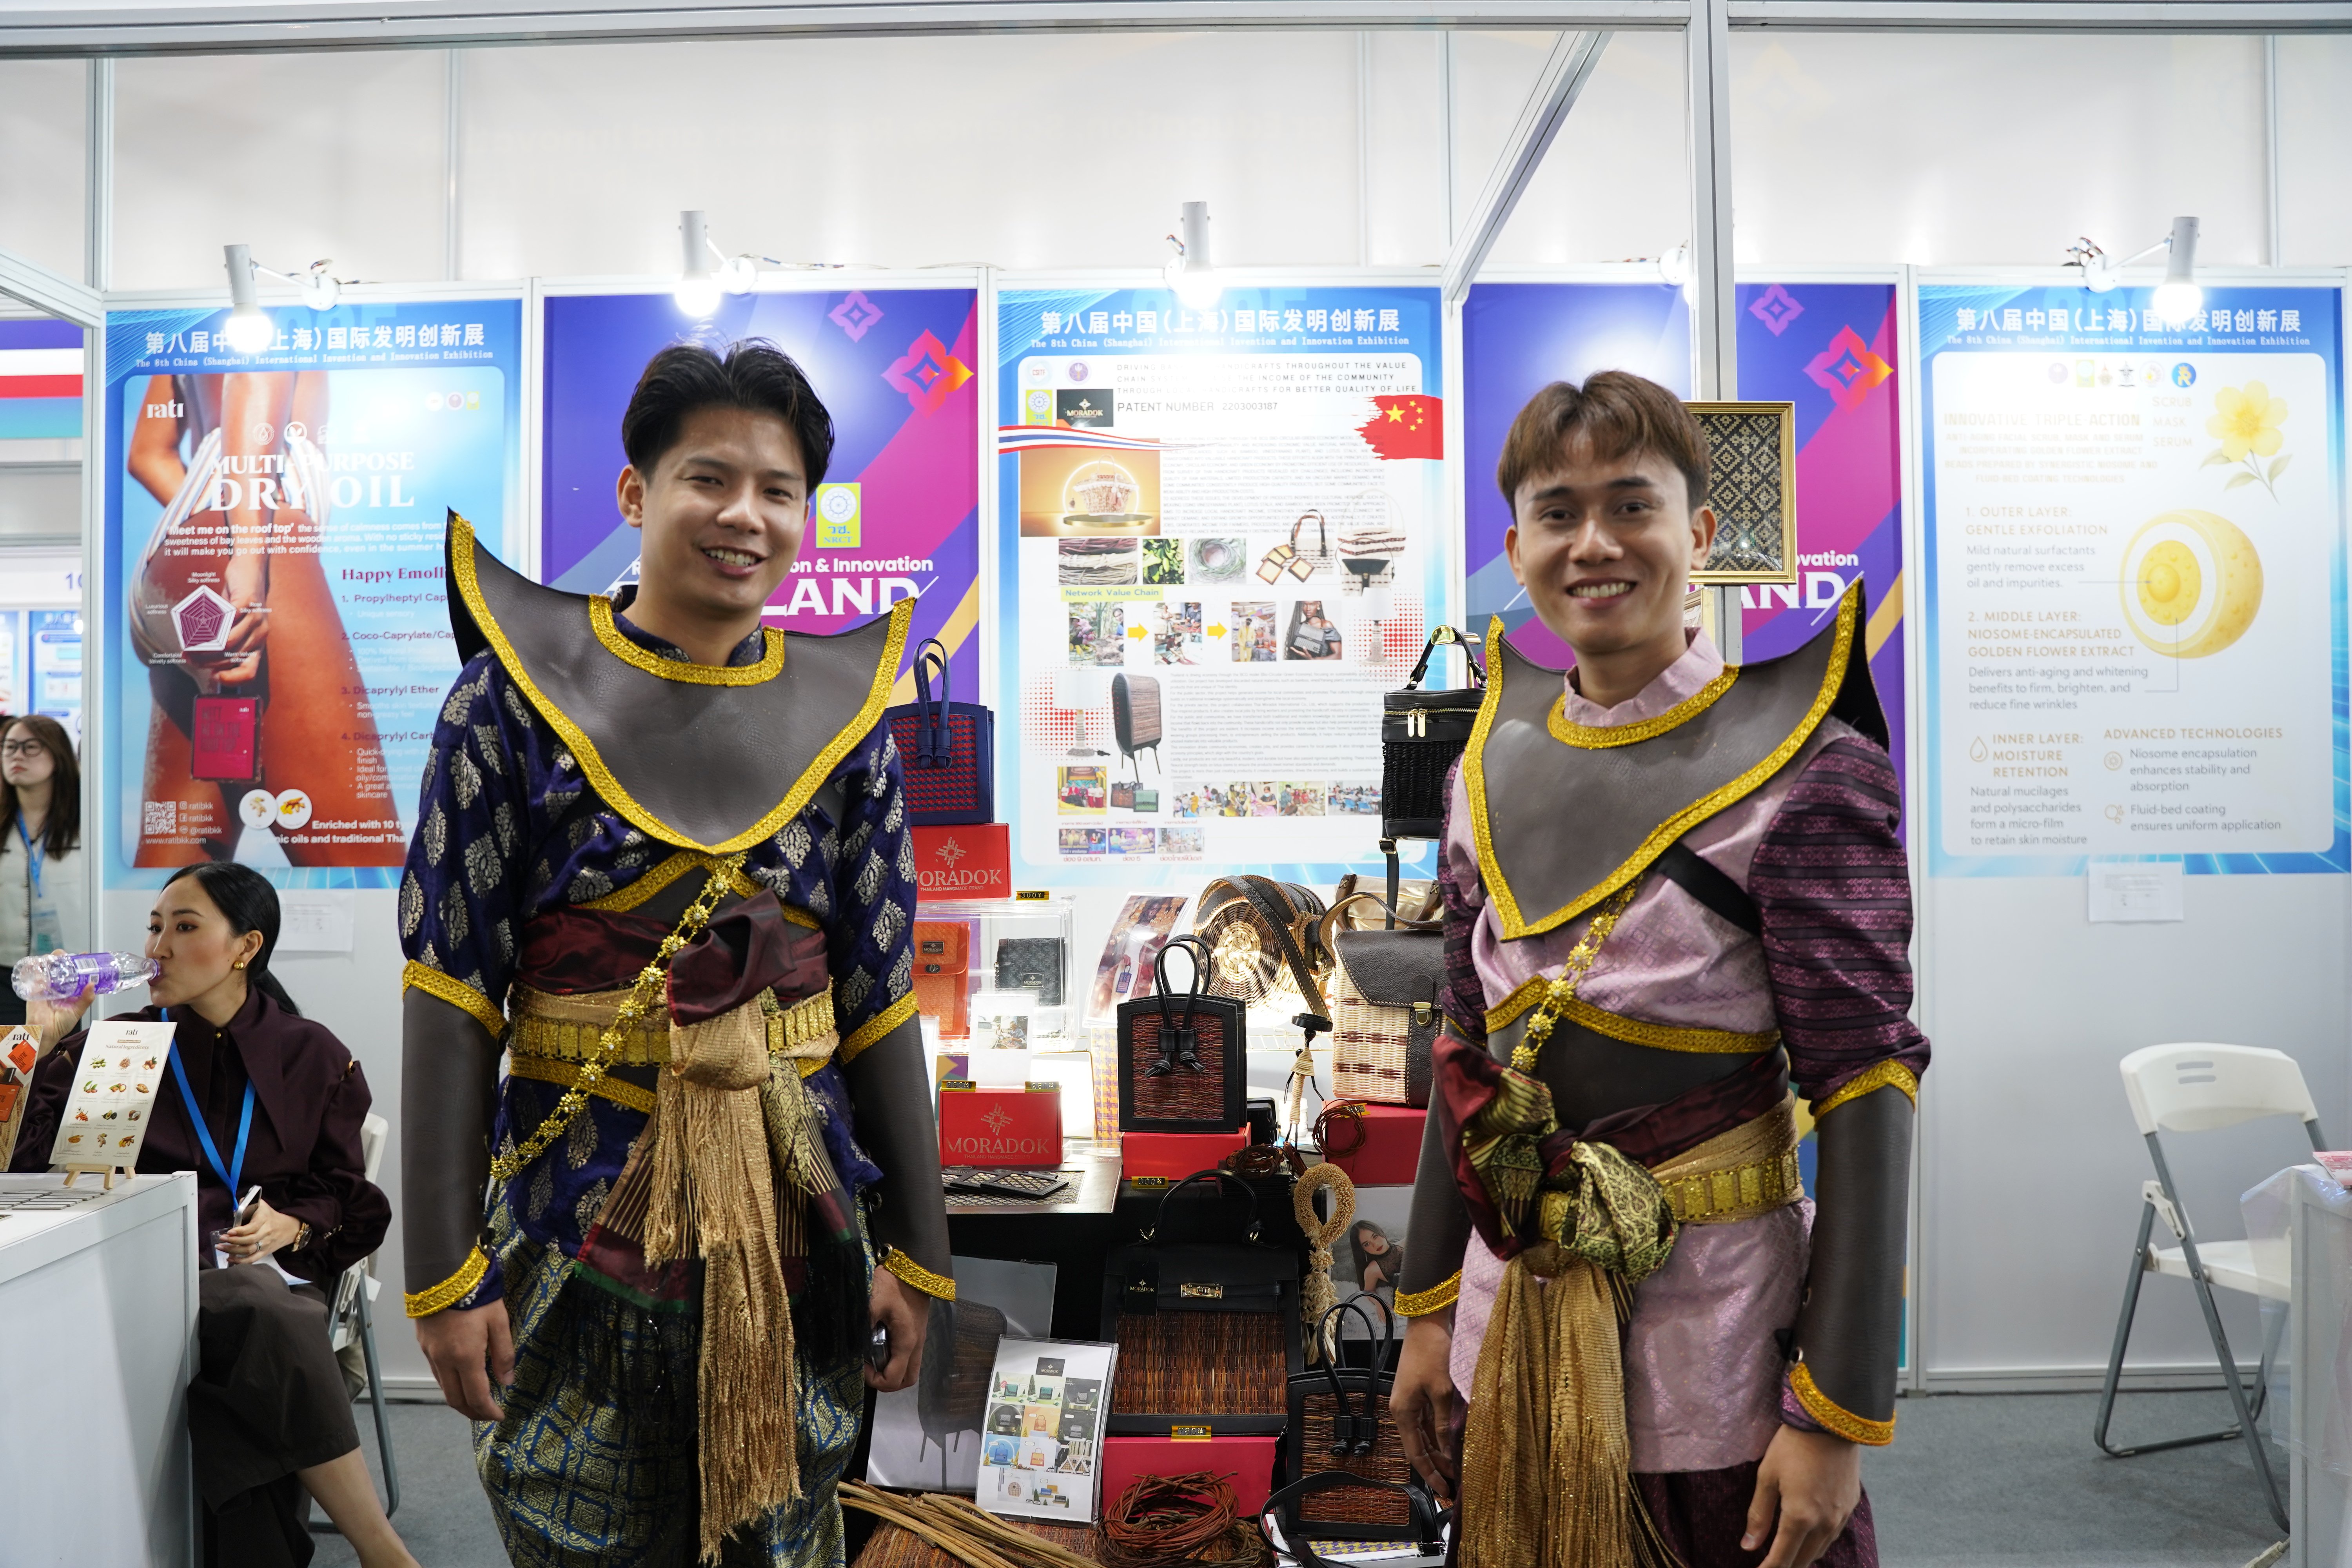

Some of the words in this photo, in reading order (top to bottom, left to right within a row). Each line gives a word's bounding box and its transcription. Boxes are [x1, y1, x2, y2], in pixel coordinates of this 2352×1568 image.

[1030, 338, 1047, 347] The
[1051, 339, 1067, 347] 8th
[1071, 339, 1098, 347] China
[1103, 338, 1152, 348] (Shanghai)
[1159, 336, 1224, 347] International
[1230, 337, 1276, 345] Invention
[1280, 336, 1297, 345] and
[1302, 337, 1353, 345] Innovation
[1357, 336, 1409, 345] Exhibition
[135, 358, 150, 367] The
[154, 358, 169, 367] 8th
[173, 357, 198, 367] China
[203, 356, 249, 367] (Shanghai)
[255, 354, 318, 364] International
[322, 353, 367, 363] Invention
[370, 352, 386, 361] and
[390, 351, 439, 361] Innovation
[443, 350, 494, 359] Exhibition
[147, 399, 184, 419] rati
[1118, 403, 1160, 411] PATENT
[1166, 402, 1214, 411] NUMBER
[209, 478, 312, 511] DRY
[330, 475, 414, 508] OIL
[197, 527, 214, 535] me
[216, 526, 229, 535] on
[231, 524, 249, 534] the
[250, 523, 272, 534] roof
[1965, 525, 2014, 535] GENTLE
[2020, 525, 2107, 535] EXFOLIATION
[265, 535, 281, 544] and
[282, 535, 297, 543] the
[173, 547, 189, 556] will
[191, 546, 215, 556] make
[217, 548, 234, 557] you
[267, 545, 287, 554] with
[815, 558, 829, 573] &
[833, 556, 933, 572] Innovation
[343, 569, 392, 583] Happy
[1984, 612, 2033, 621] MIDDLE
[1968, 646, 2022, 657] GOLDEN
[2026, 646, 2076, 657] FLOWER
[2081, 646, 2134, 657] EXTRACT
[1993, 734, 2034, 744] INNER
[2104, 728, 2176, 739] ADVANCED
[2180, 728, 2283, 739] TECHNOLOGIES
[1993, 750, 2062, 761] MOISTURE
[2130, 749, 2178, 758] Niosome
[1993, 766, 2068, 778] RETENTION
[2185, 764, 2226, 774] stability
[2230, 765, 2250, 774] and
[312, 820, 358, 829] Enriched
[359, 819, 381, 829] with
[383, 820, 394, 829] 10
[2221, 822, 2281, 830] application
[290, 835, 309, 844] oils
[311, 834, 330, 844] and
[332, 833, 384, 844] traditional
[917, 869, 1002, 887] ORADOK
[945, 1138, 1050, 1154] MORADOK
